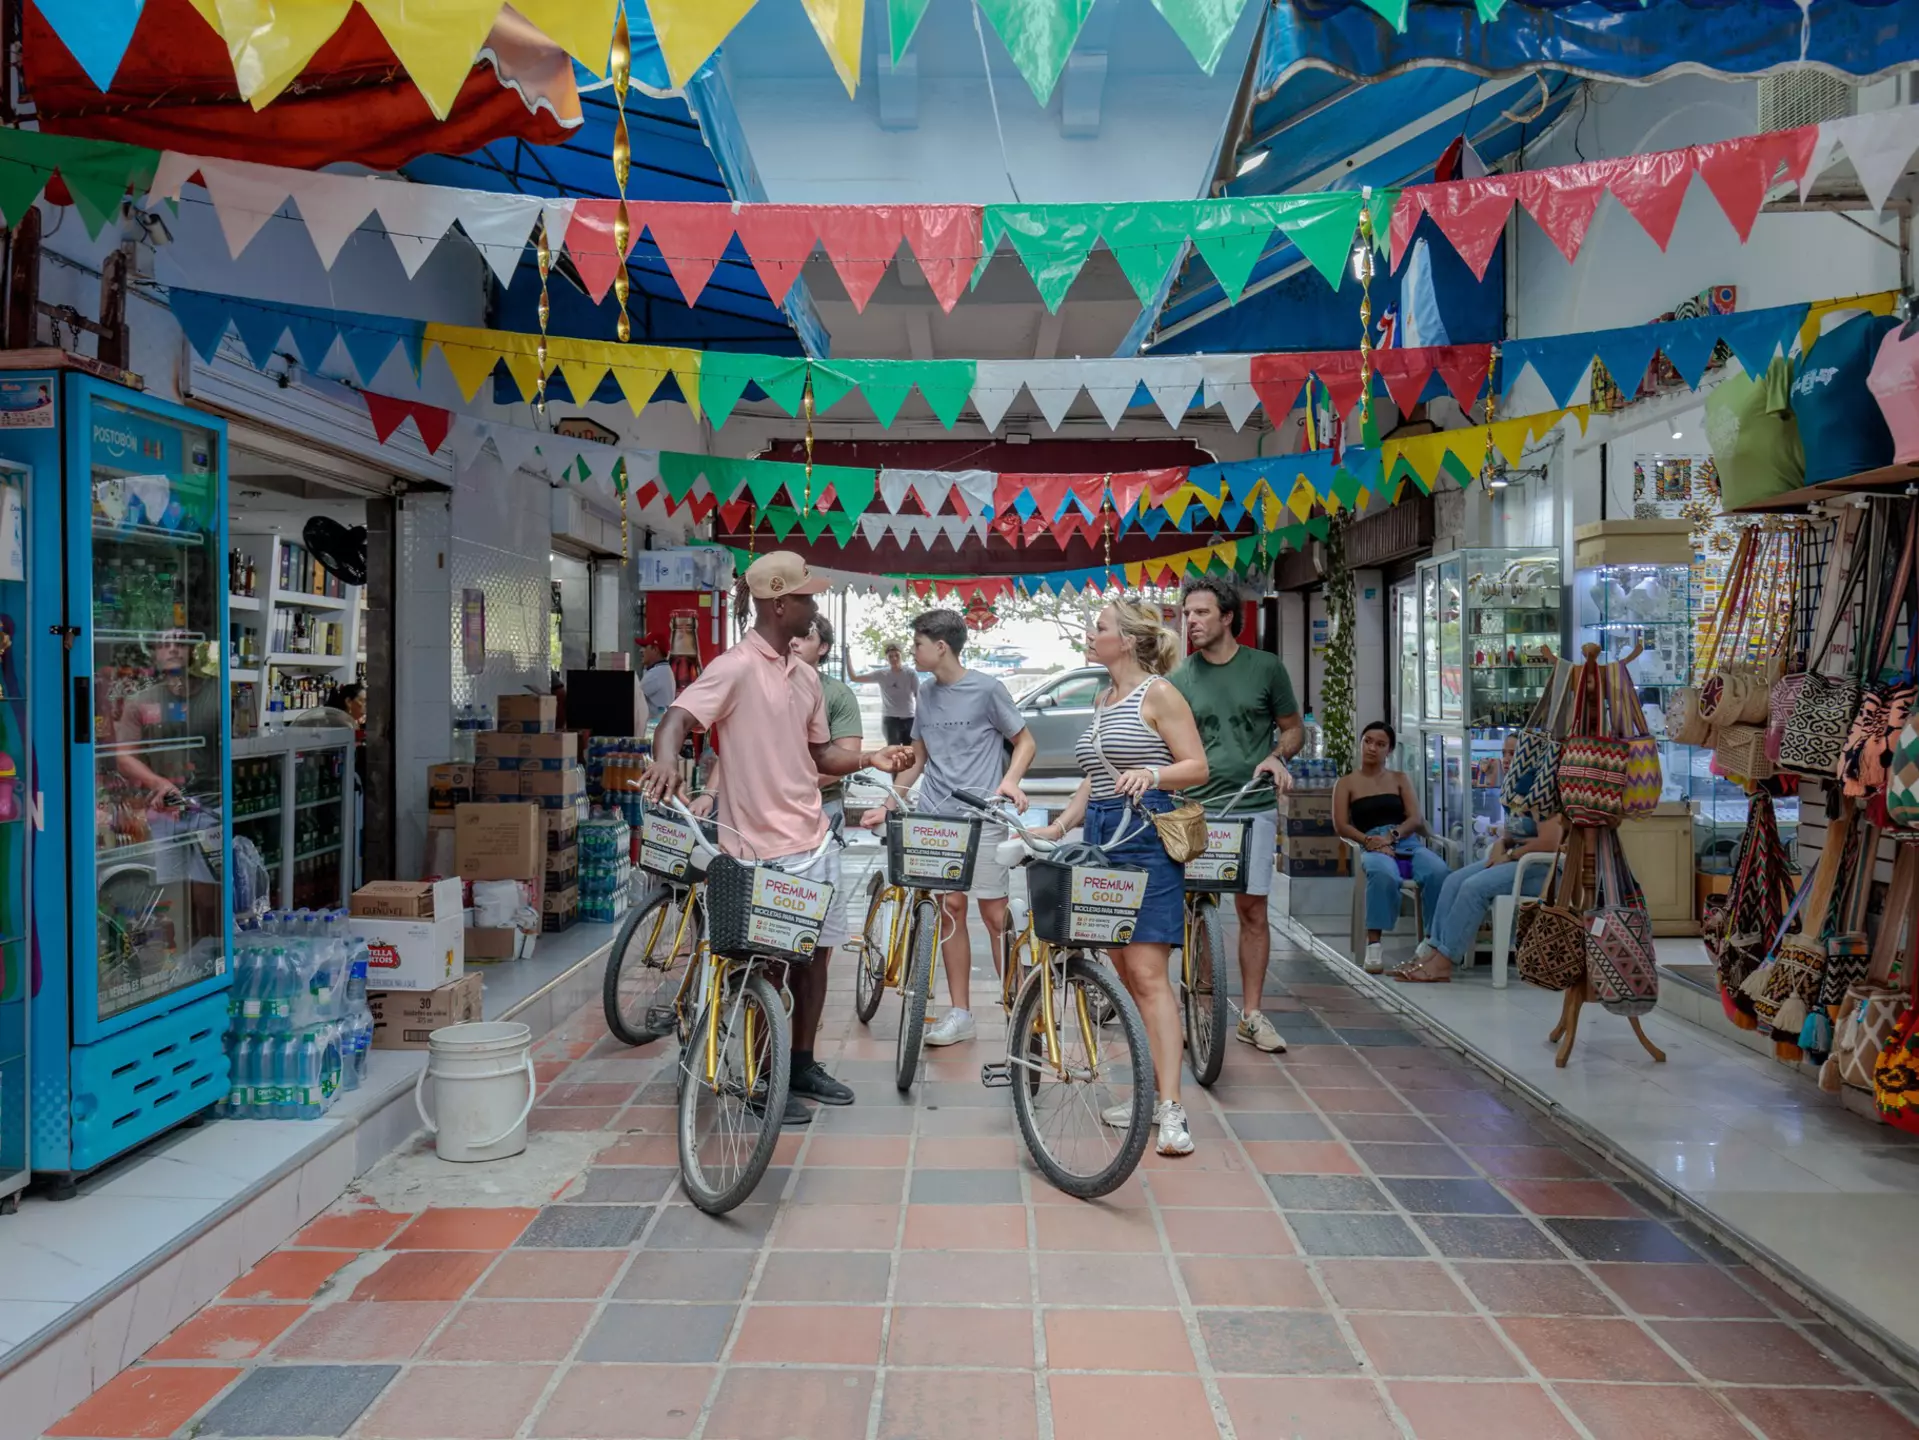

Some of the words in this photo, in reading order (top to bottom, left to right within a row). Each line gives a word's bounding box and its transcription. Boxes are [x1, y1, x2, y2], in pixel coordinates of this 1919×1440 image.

[652, 822, 687, 840] PREMIUM
[913, 826, 958, 838] PREMIUM
[1207, 830, 1231, 839] MIUM
[656, 833, 678, 846] GOLD
[921, 837, 949, 847] GOLD
[1210, 841, 1222, 849] LD
[1083, 876, 1134, 892] PREMIUM
[765, 879, 818, 902] PREMIUM
[773, 895, 806, 911] GOLD
[1092, 891, 1123, 903] GOLD
[369, 949, 393, 957] TELLA
[369, 956, 393, 964] RTOIS
[419, 998, 431, 1010] 30
